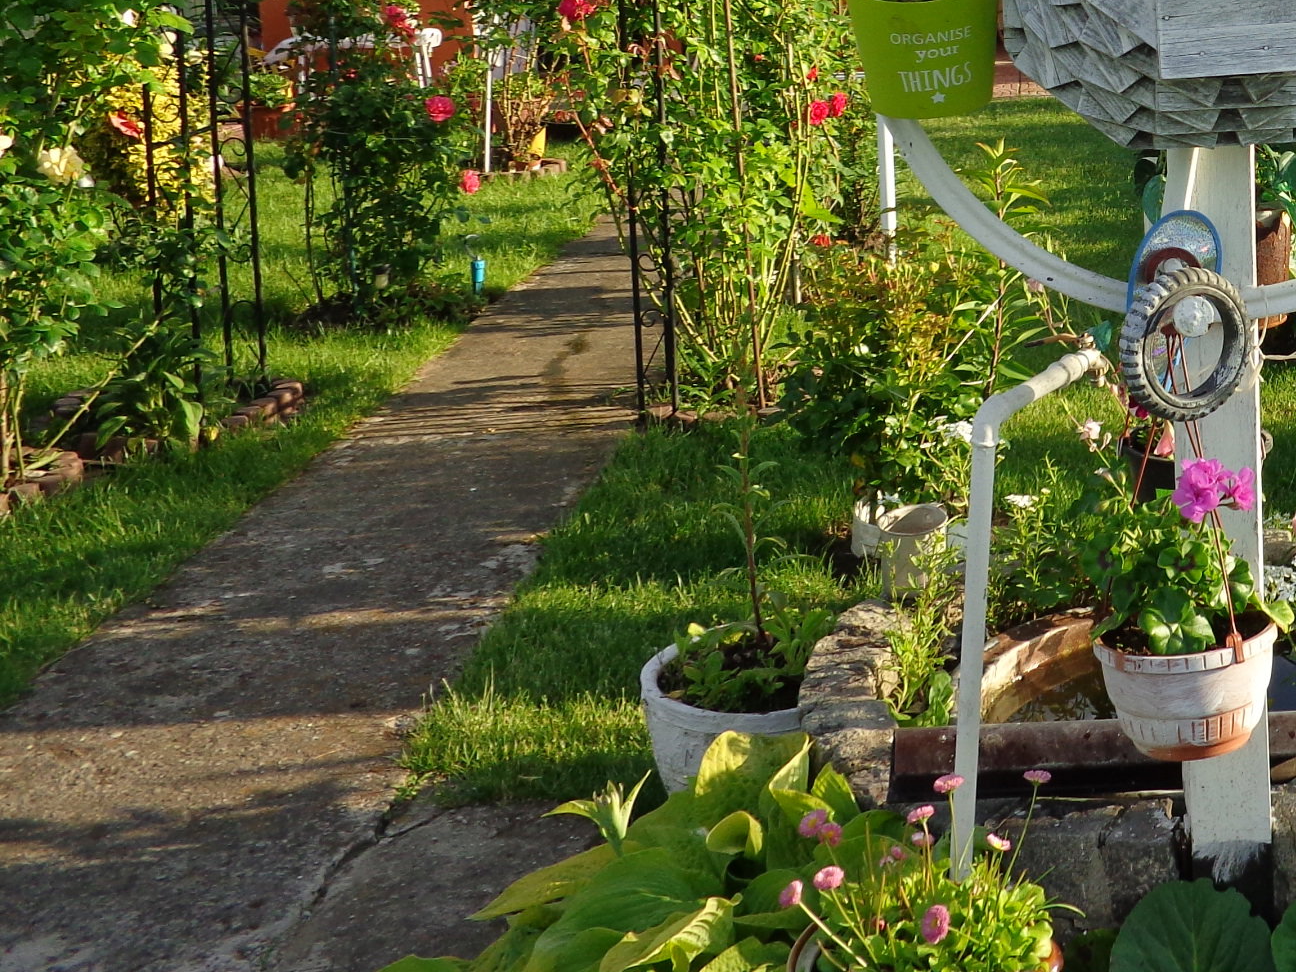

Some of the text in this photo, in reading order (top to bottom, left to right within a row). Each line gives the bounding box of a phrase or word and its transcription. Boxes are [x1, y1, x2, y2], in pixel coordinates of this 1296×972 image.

[889, 25, 973, 45] ORGANISE
[914, 45, 960, 64] your
[897, 61, 973, 93] THINGS
